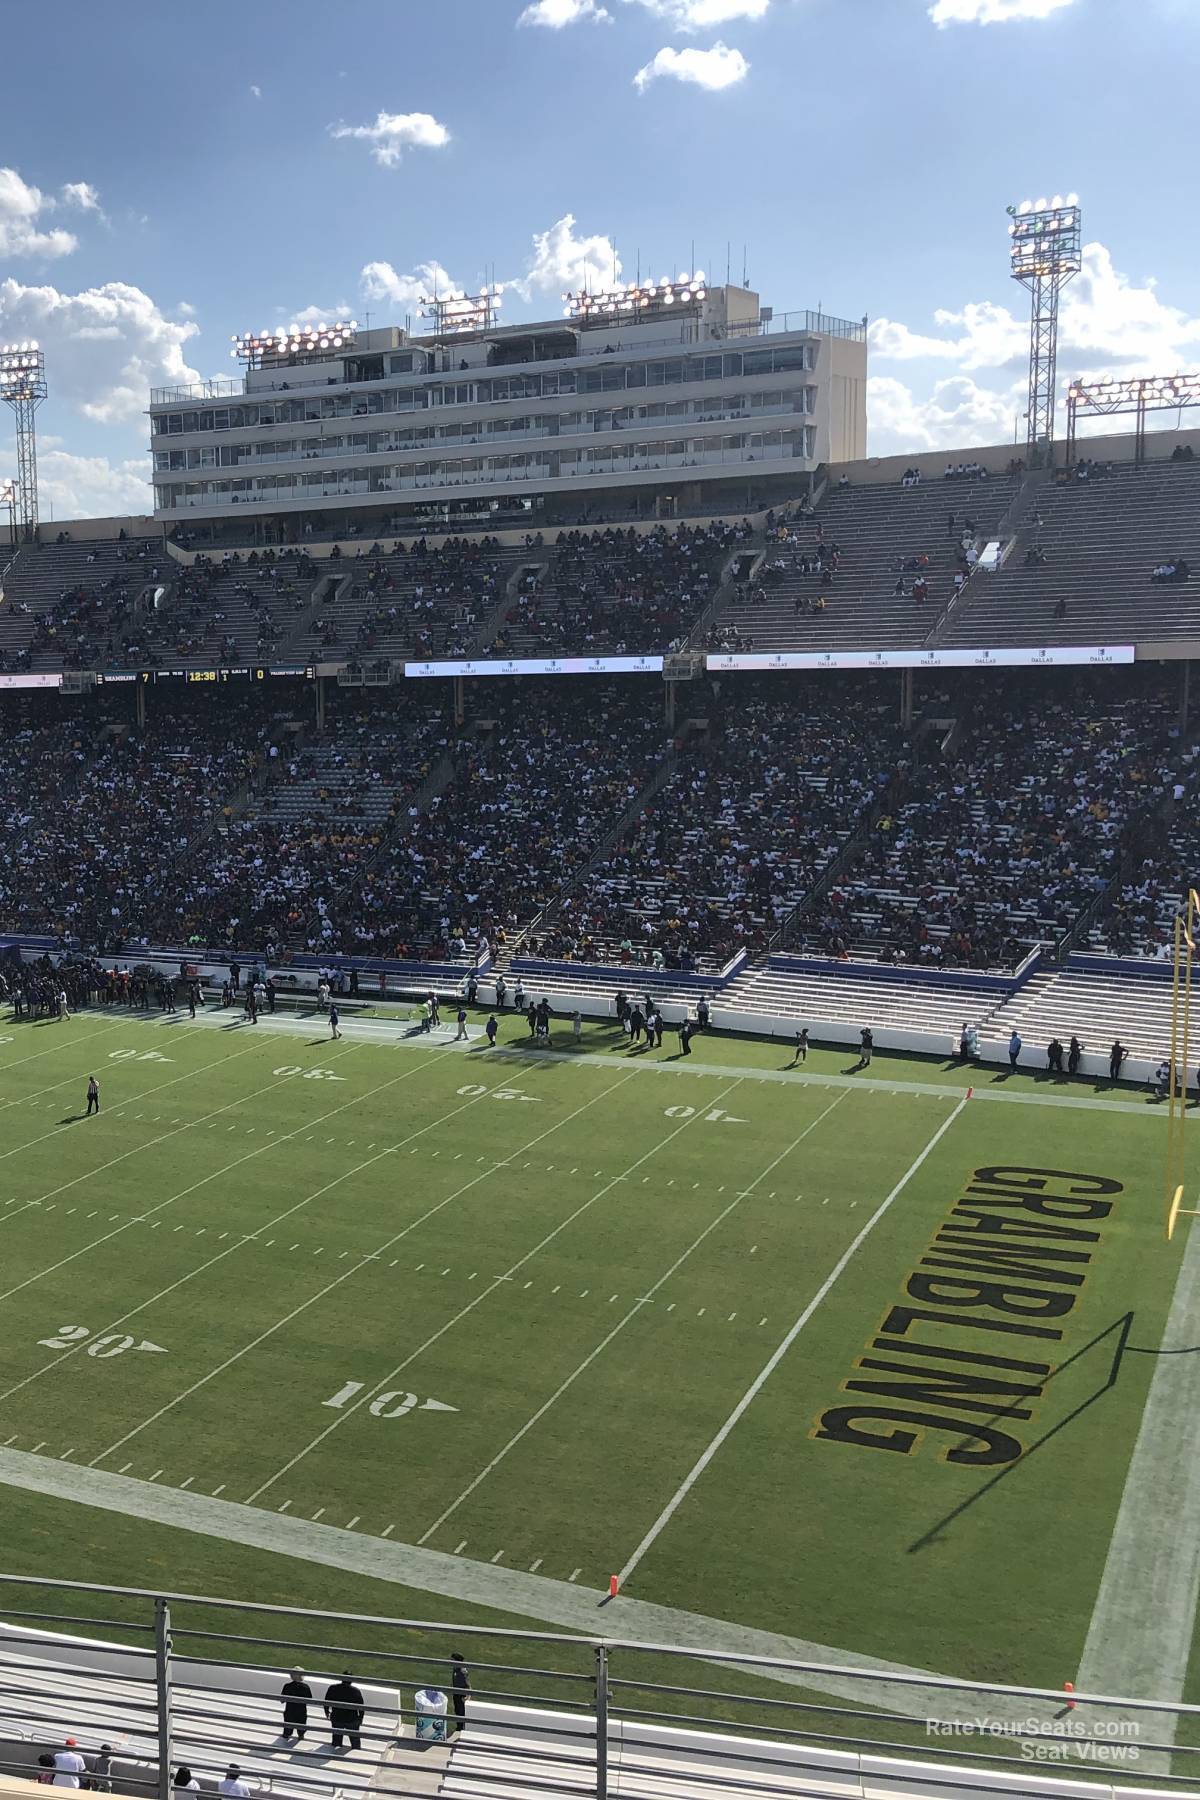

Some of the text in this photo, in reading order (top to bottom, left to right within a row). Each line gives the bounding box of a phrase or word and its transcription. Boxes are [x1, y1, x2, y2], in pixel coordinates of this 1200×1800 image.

[142, 673, 149, 683] 7
[189, 671, 215, 682] 12:38
[811, 1164, 1125, 1467] GRAMBLING
[36, 1325, 135, 1358] 20
[321, 1381, 419, 1418] 10
